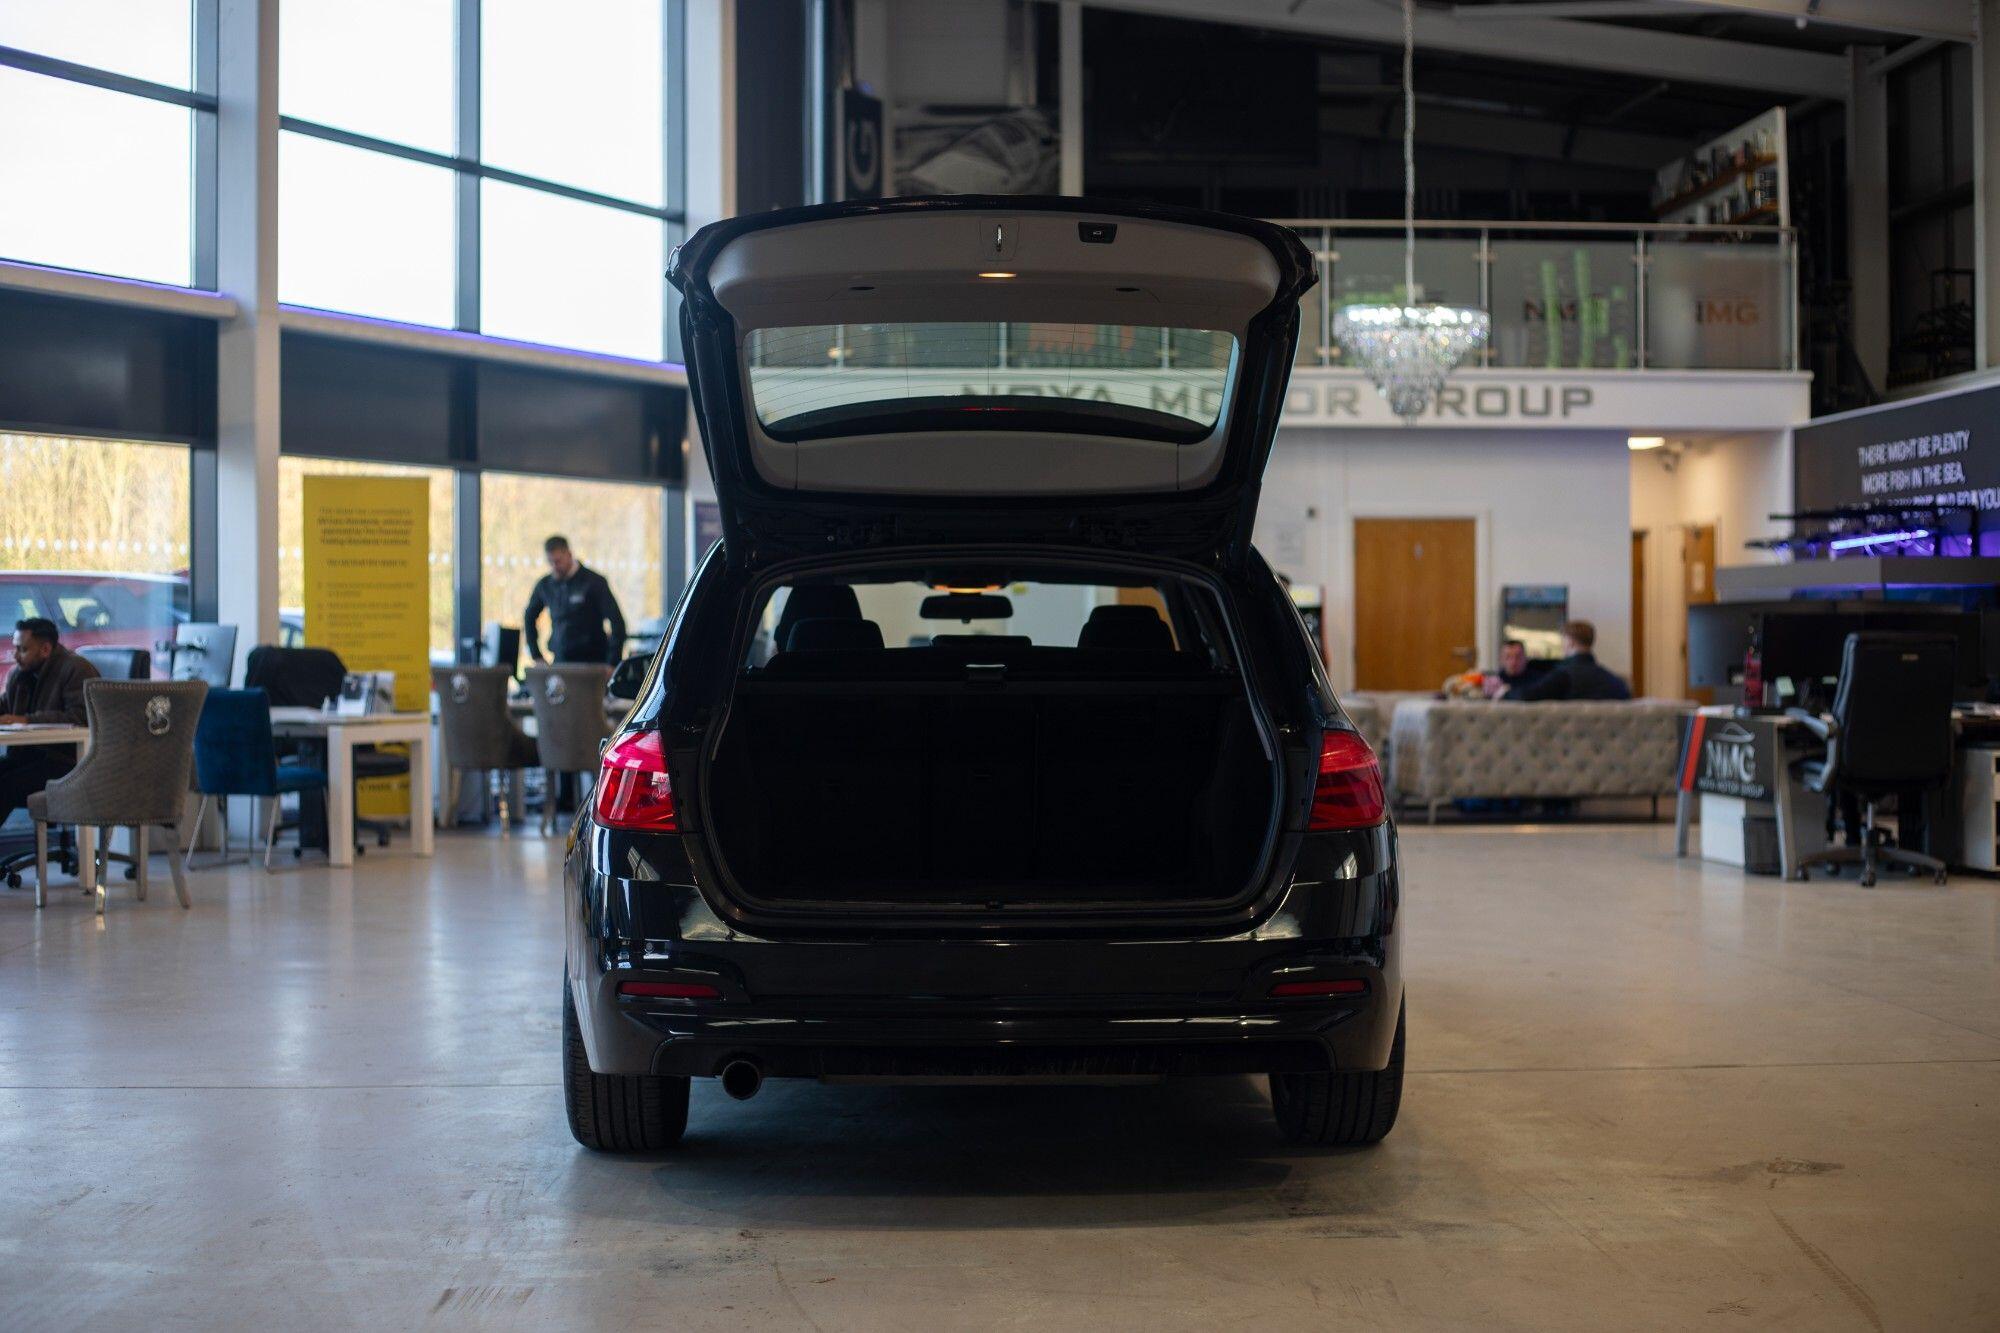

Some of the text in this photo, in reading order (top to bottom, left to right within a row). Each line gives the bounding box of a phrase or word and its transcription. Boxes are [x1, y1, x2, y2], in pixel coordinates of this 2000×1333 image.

[1857, 429, 1970, 467] THERE MIGHT BE PLENTY
[1862, 471, 1889, 494] MORE
[1911, 467, 1923, 489] IN
[1923, 463, 1942, 487] THE
[1705, 740, 1756, 782] NMG
